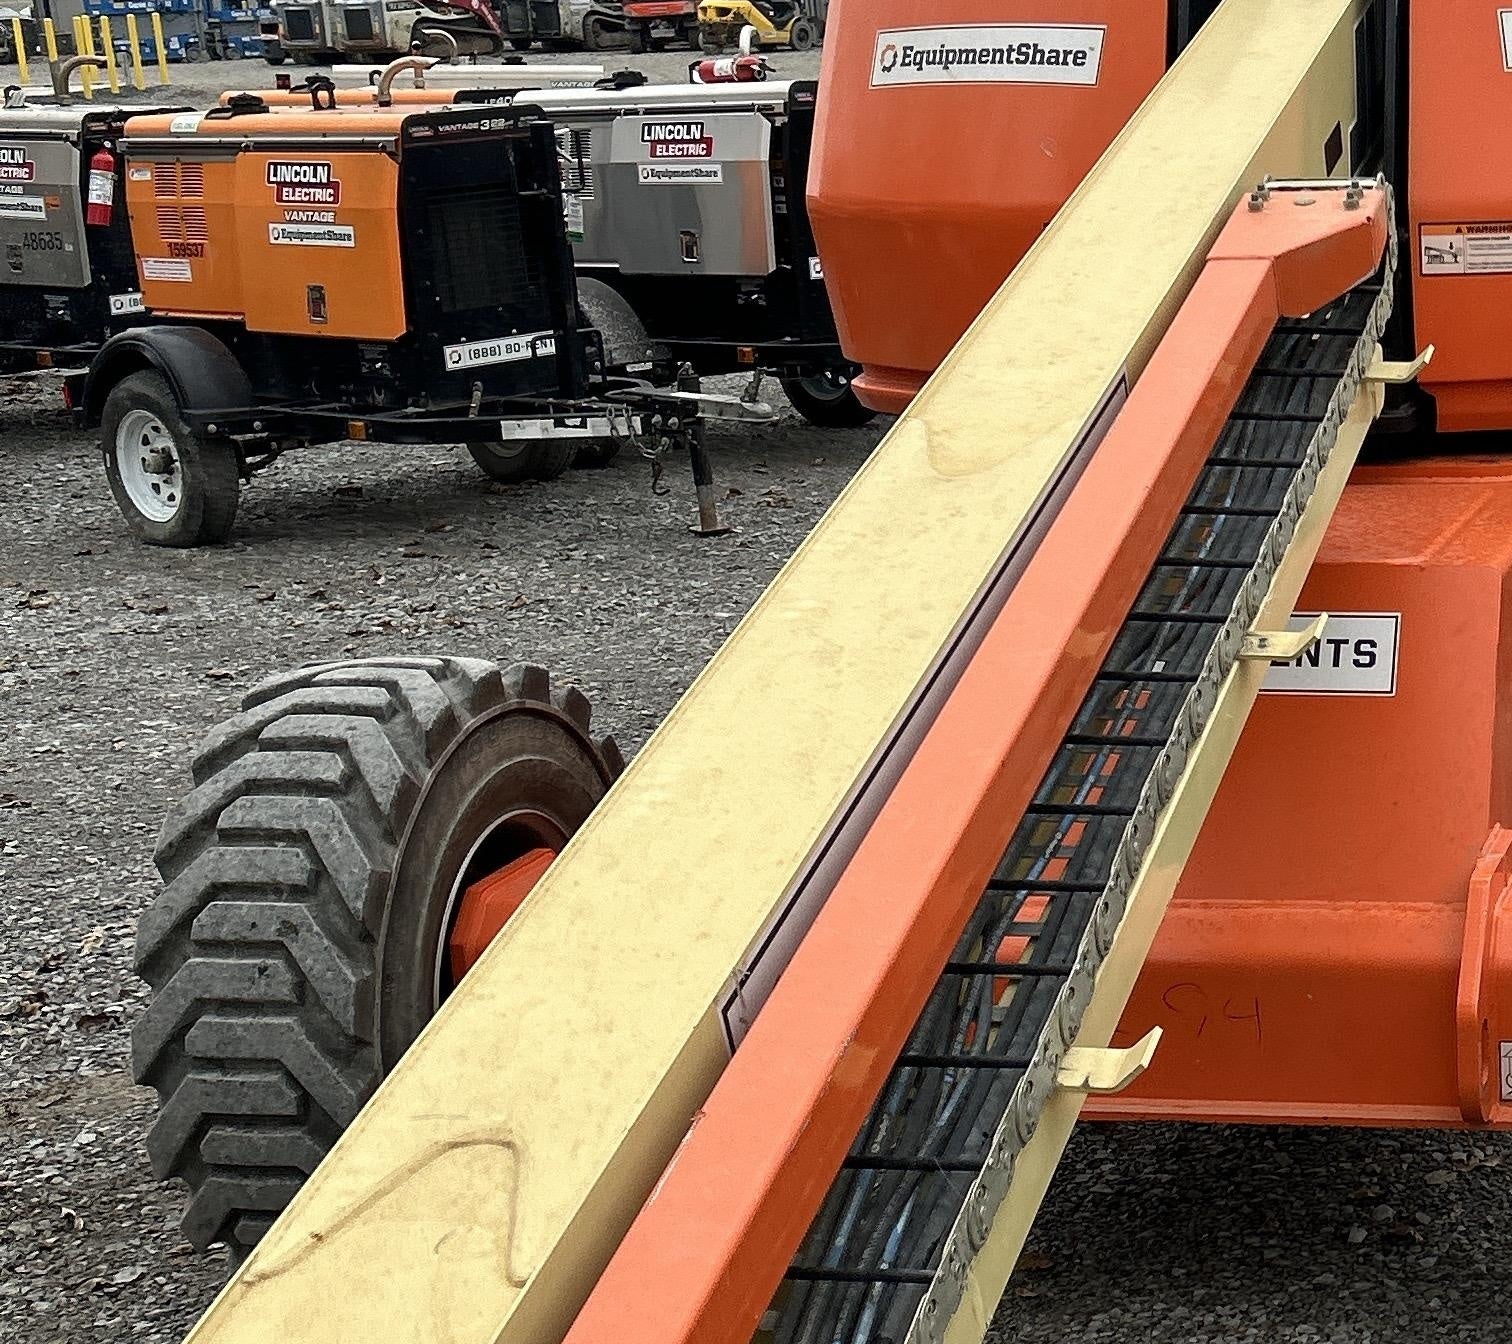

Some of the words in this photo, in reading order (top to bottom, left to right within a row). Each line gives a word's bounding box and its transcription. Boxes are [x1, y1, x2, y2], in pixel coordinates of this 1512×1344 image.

[900, 42, 1088, 71] EquipmentShare
[643, 124, 702, 141] LINCOLN
[656, 143, 707, 156] ELECTRIC
[269, 164, 328, 184] LINCOLN
[650, 167, 719, 180] EquipmentShare
[282, 188, 334, 202] ELECTRIC
[284, 210, 335, 223] VANTAGE
[281, 227, 352, 243] EquipmentShare
[468, 345, 502, 360] (888)
[1270, 638, 1378, 669] NTS
